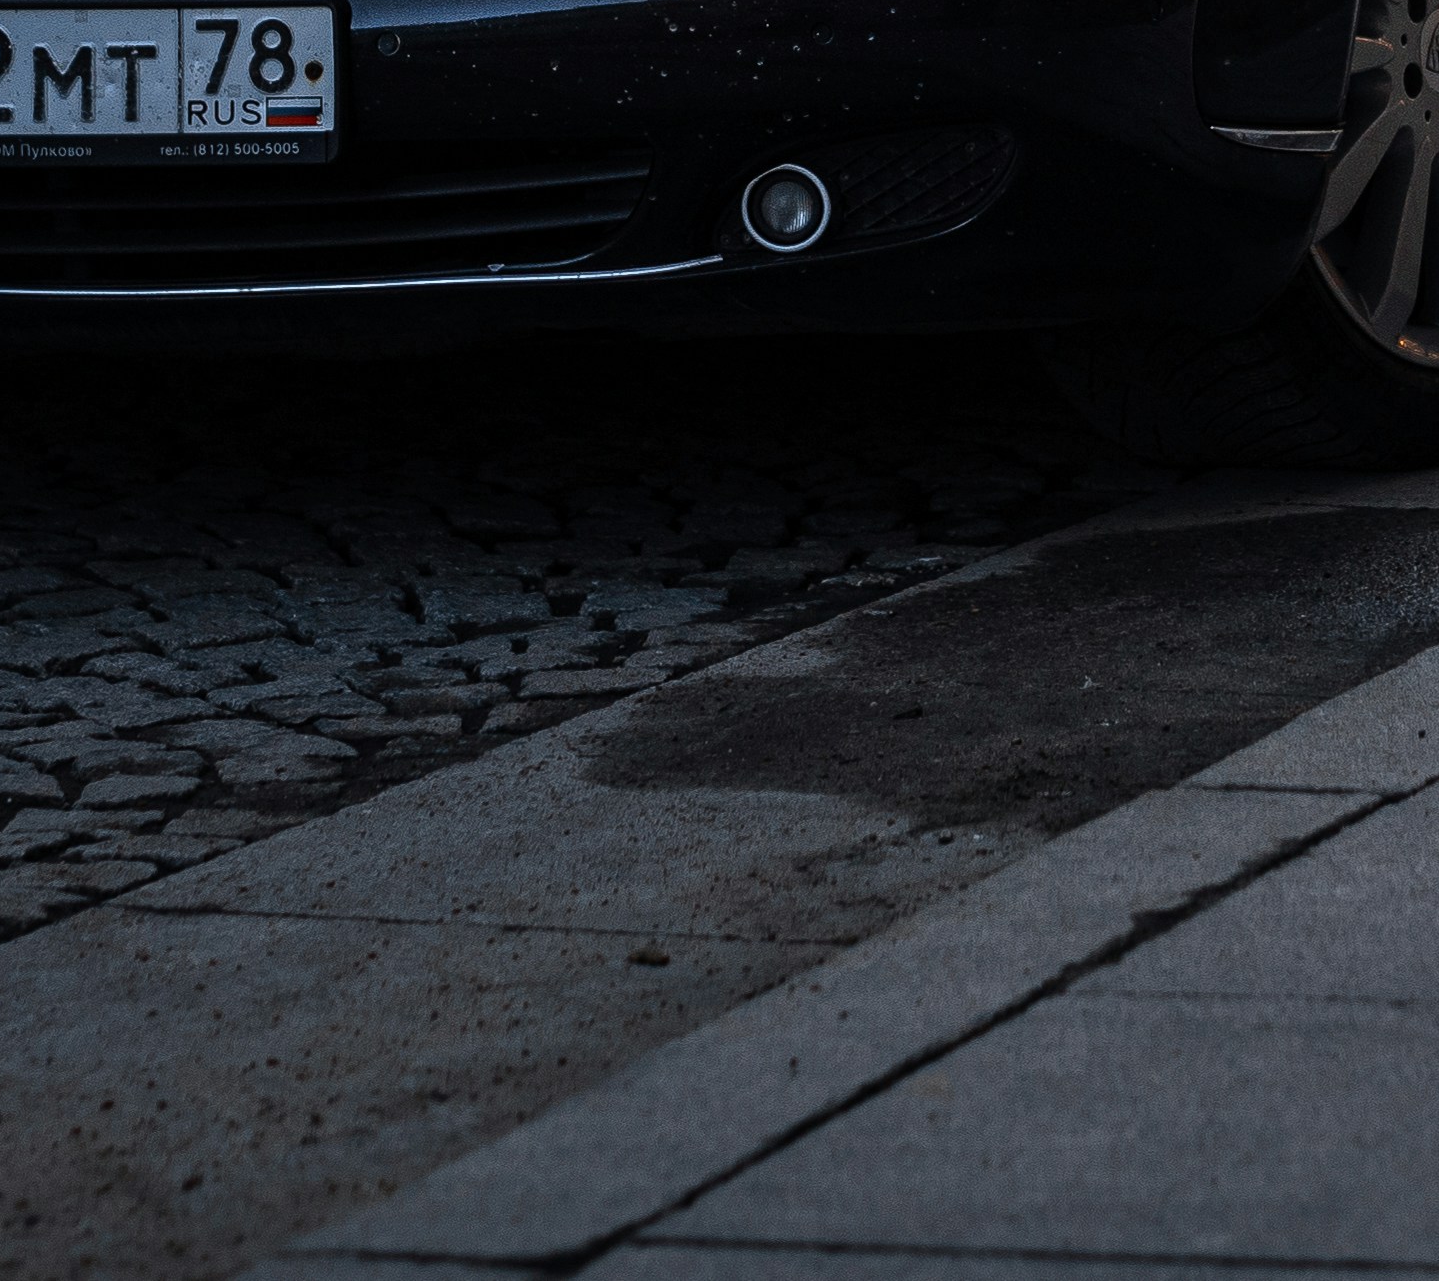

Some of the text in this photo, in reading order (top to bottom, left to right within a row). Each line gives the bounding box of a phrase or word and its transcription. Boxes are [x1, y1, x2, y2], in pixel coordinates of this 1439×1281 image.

[194, 17, 296, 96] 78
[187, 99, 262, 127] RUS
[20, 141, 93, 160] Пулково»
[193, 142, 230, 159] (812)
[233, 142, 301, 156] 500-5005
